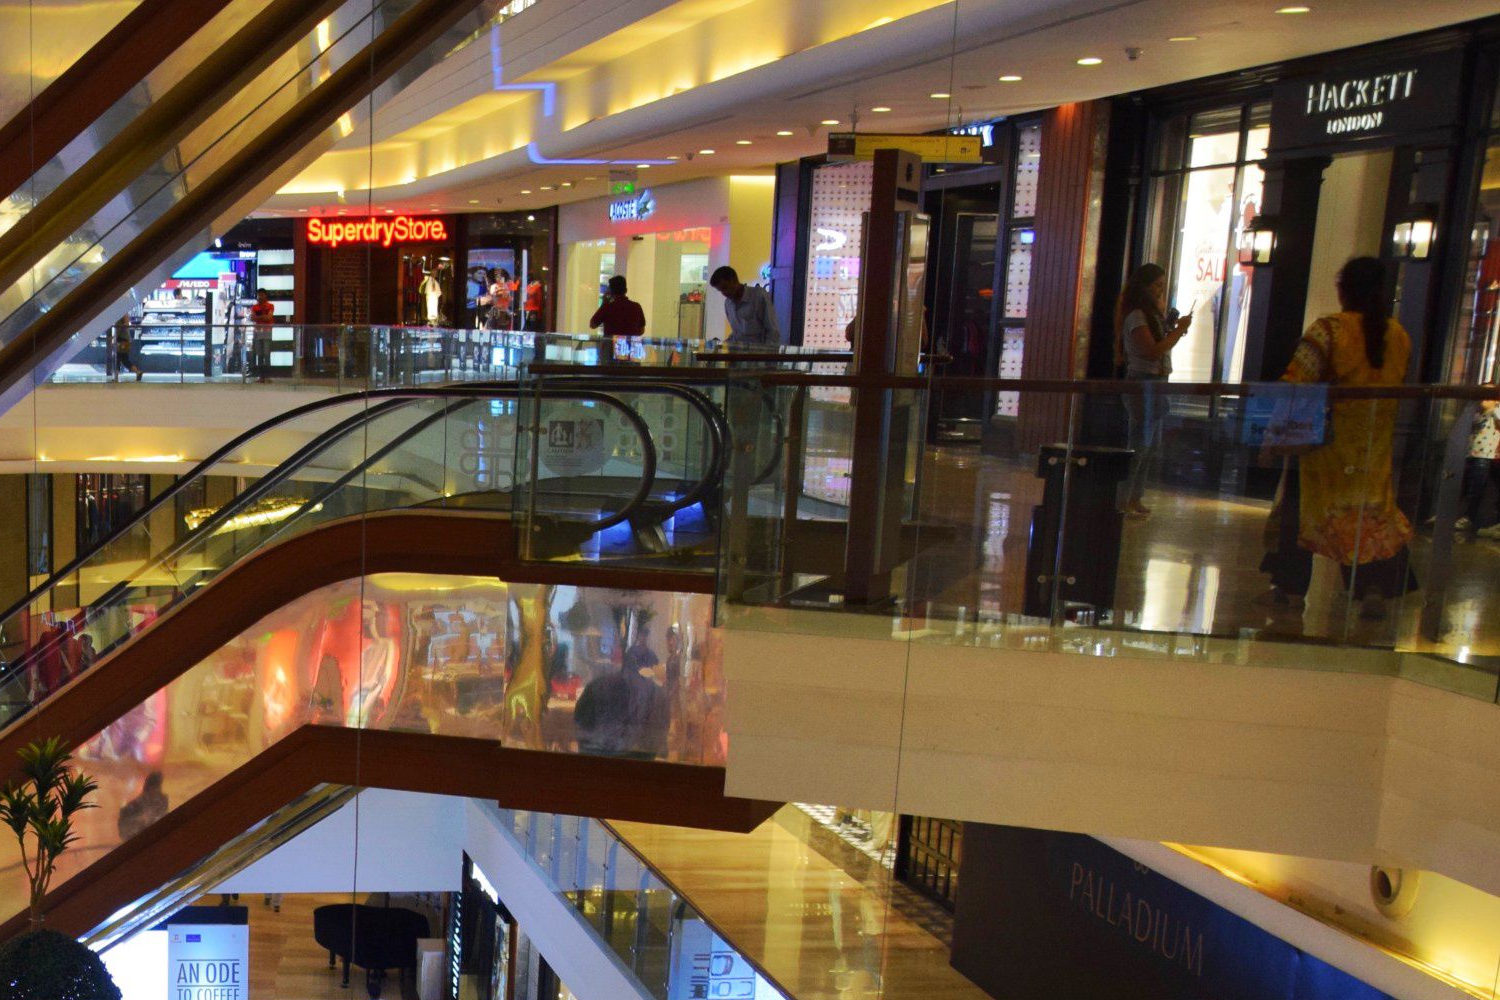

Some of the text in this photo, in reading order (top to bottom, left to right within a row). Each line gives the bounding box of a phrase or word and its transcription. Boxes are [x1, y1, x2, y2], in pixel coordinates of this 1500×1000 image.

[1306, 69, 1417, 114] HACKETT
[1326, 112, 1383, 134] LONDON
[609, 200, 638, 221] LACOSTE
[1070, 863, 1204, 967] PALLADIUM
[177, 962, 240, 984] AN ODE
